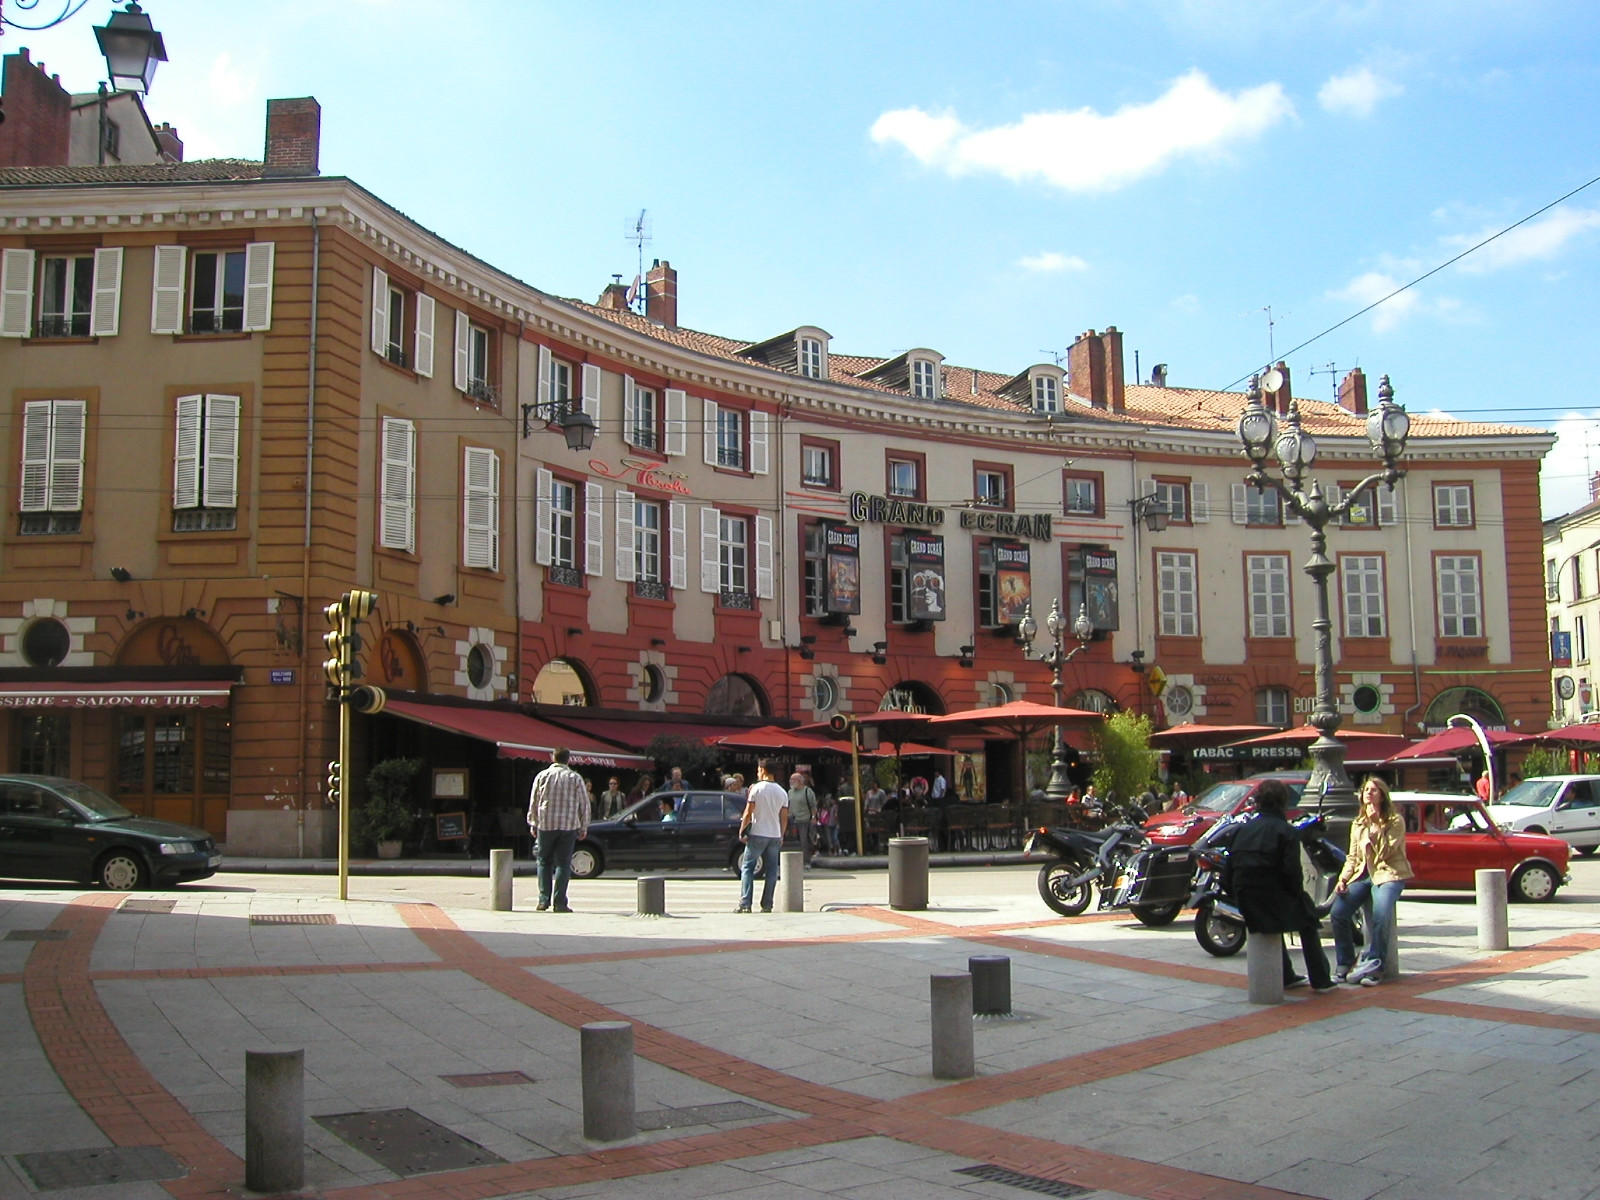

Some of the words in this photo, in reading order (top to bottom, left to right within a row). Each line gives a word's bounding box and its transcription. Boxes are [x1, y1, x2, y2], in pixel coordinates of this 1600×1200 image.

[850, 491, 945, 525] GRAND
[959, 510, 1054, 542] ECRAN
[827, 529, 843, 545] GRAND
[843, 533, 858, 548] ECRAN
[910, 540, 926, 554] GRAND
[927, 543, 942, 557] ECRAN
[997, 548, 1013, 561] GRAND
[1013, 550, 1029, 563] ECRAN
[75, 696, 134, 706] SALON
[140, 696, 158, 705] de
[1193, 747, 1234, 758] TABAC
[1252, 747, 1302, 757] PRESSE
